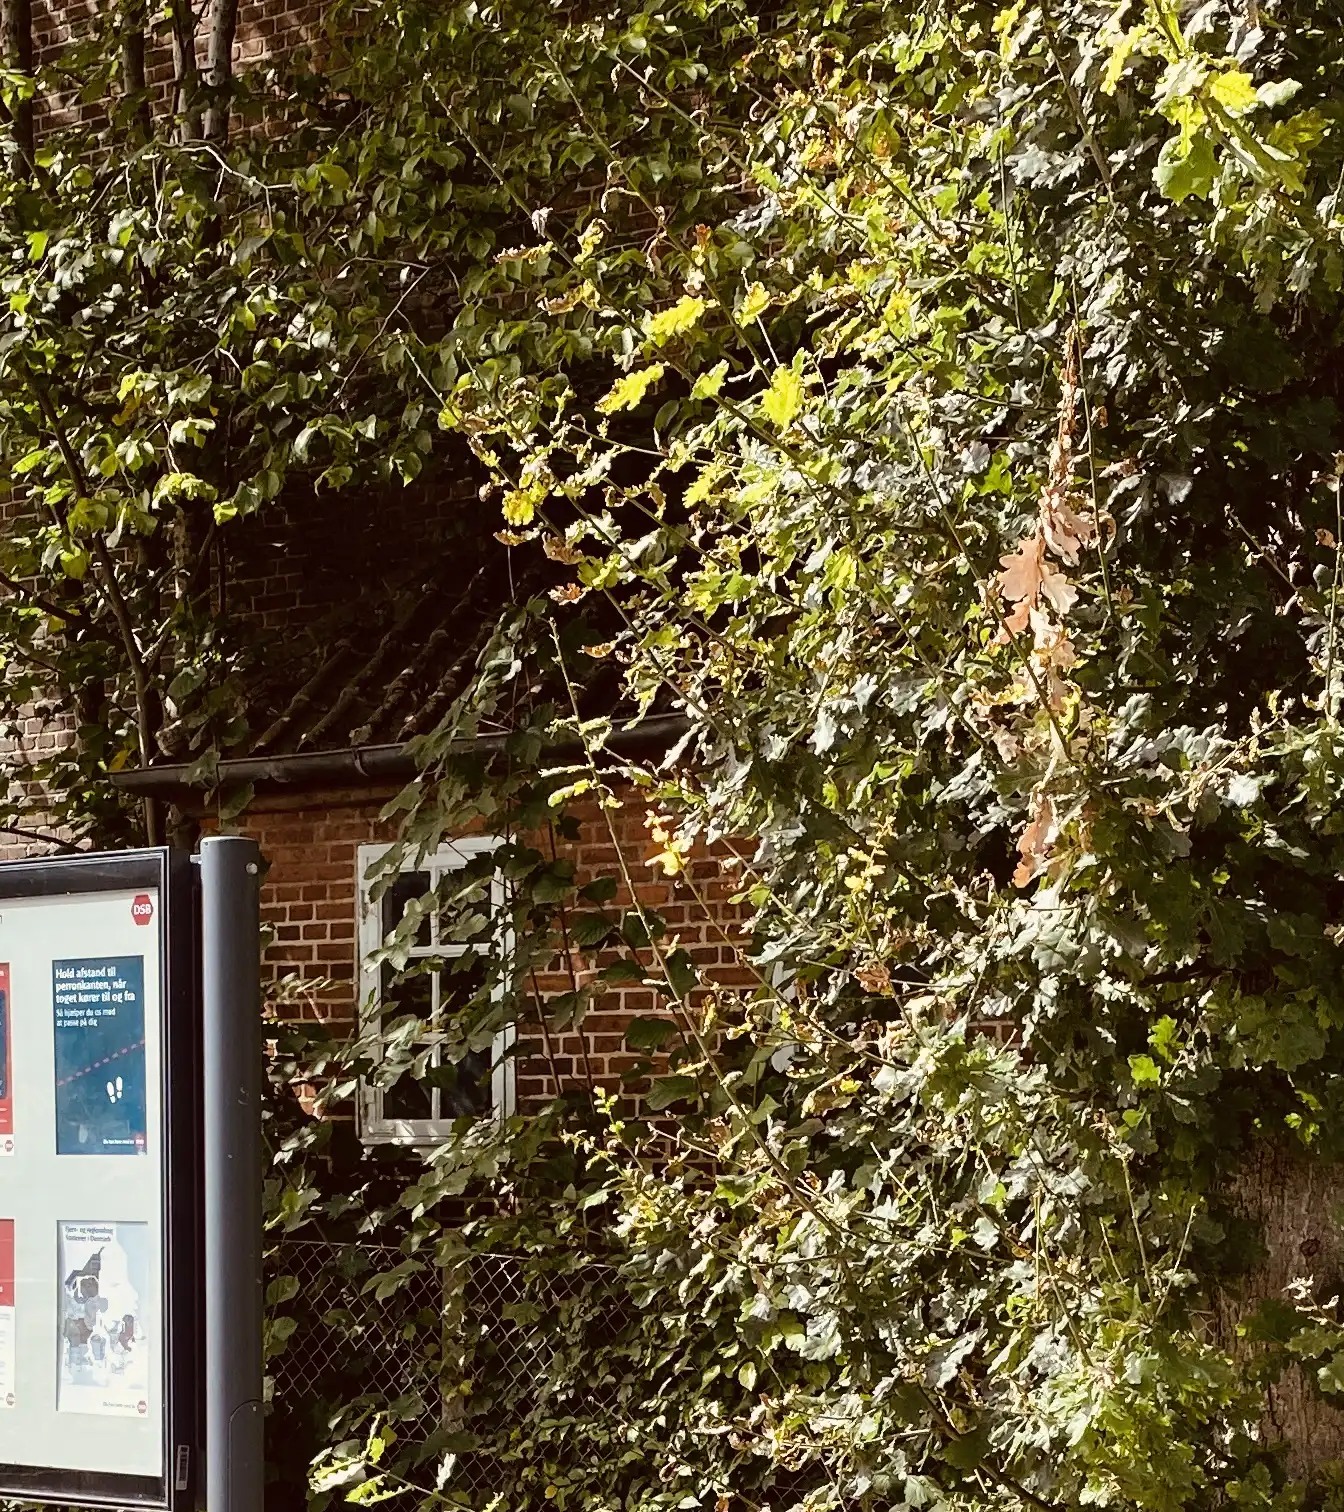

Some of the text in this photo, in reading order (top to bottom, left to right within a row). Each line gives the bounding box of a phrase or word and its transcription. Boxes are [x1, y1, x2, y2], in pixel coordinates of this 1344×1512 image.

[134, 904, 152, 915] DSB
[56, 966, 116, 978] Hold afstand til
[56, 978, 126, 993] perronkanten, når
[56, 990, 136, 1004] toget kører til og fra
